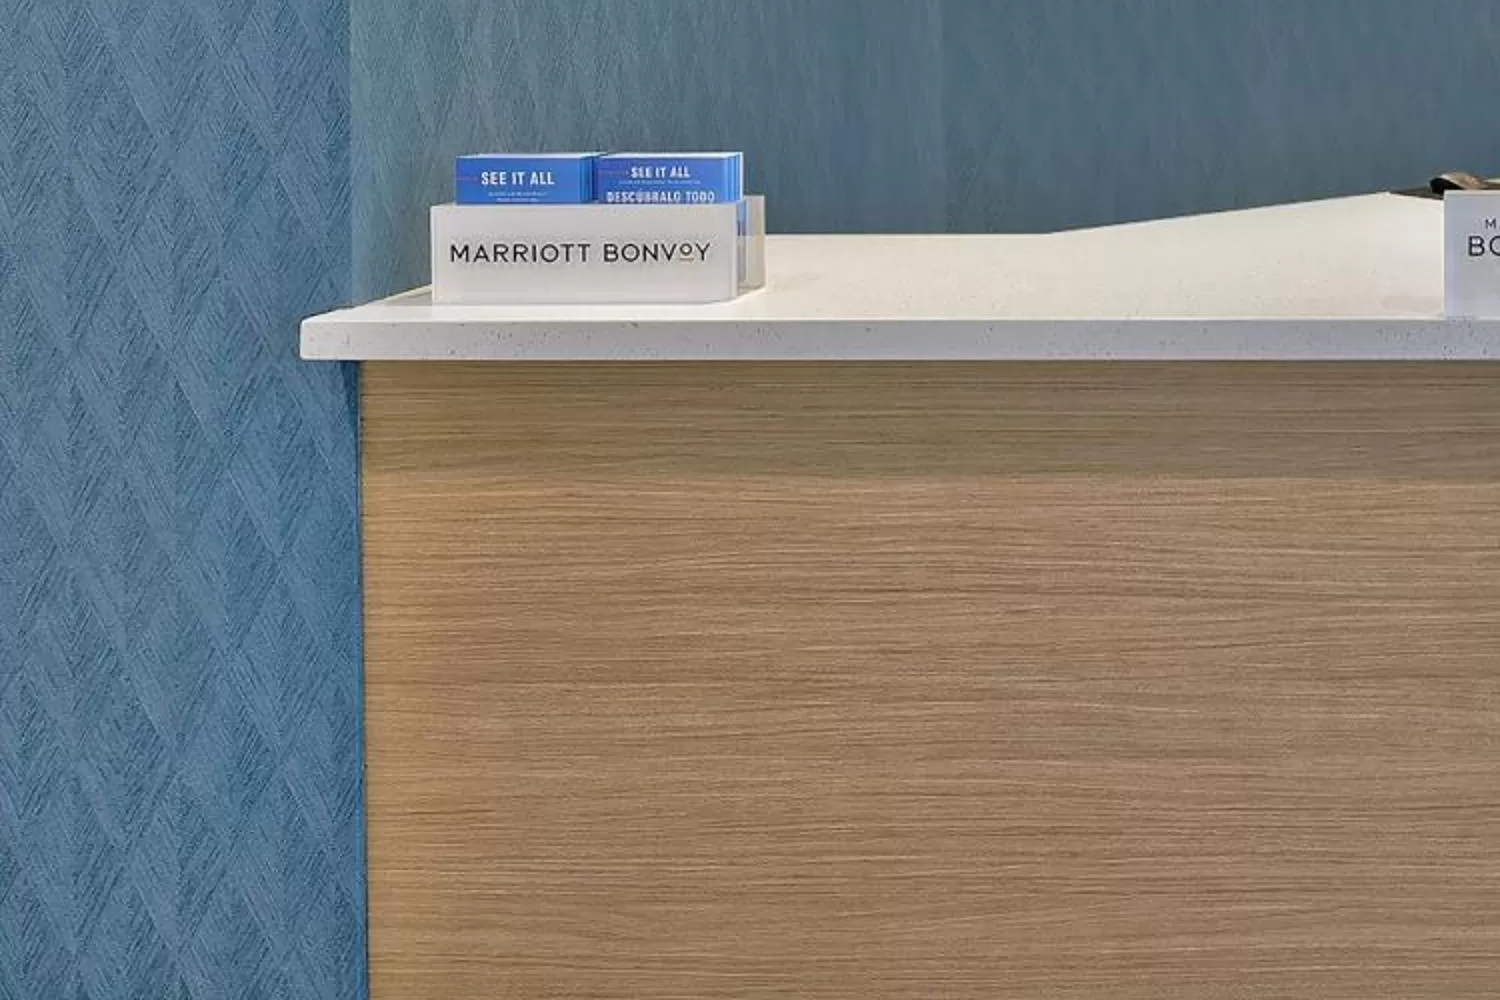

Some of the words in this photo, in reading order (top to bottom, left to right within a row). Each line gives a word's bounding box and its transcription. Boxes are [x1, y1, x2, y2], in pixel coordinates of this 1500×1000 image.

[481, 171, 507, 186] SEE
[511, 171, 525, 186] IT
[529, 171, 555, 186] ALL
[631, 166, 653, 179] SEE
[655, 166, 667, 179] IT
[669, 166, 690, 179] ALL
[450, 244, 591, 263] MARRIOTT
[603, 243, 711, 263] BONVOY
